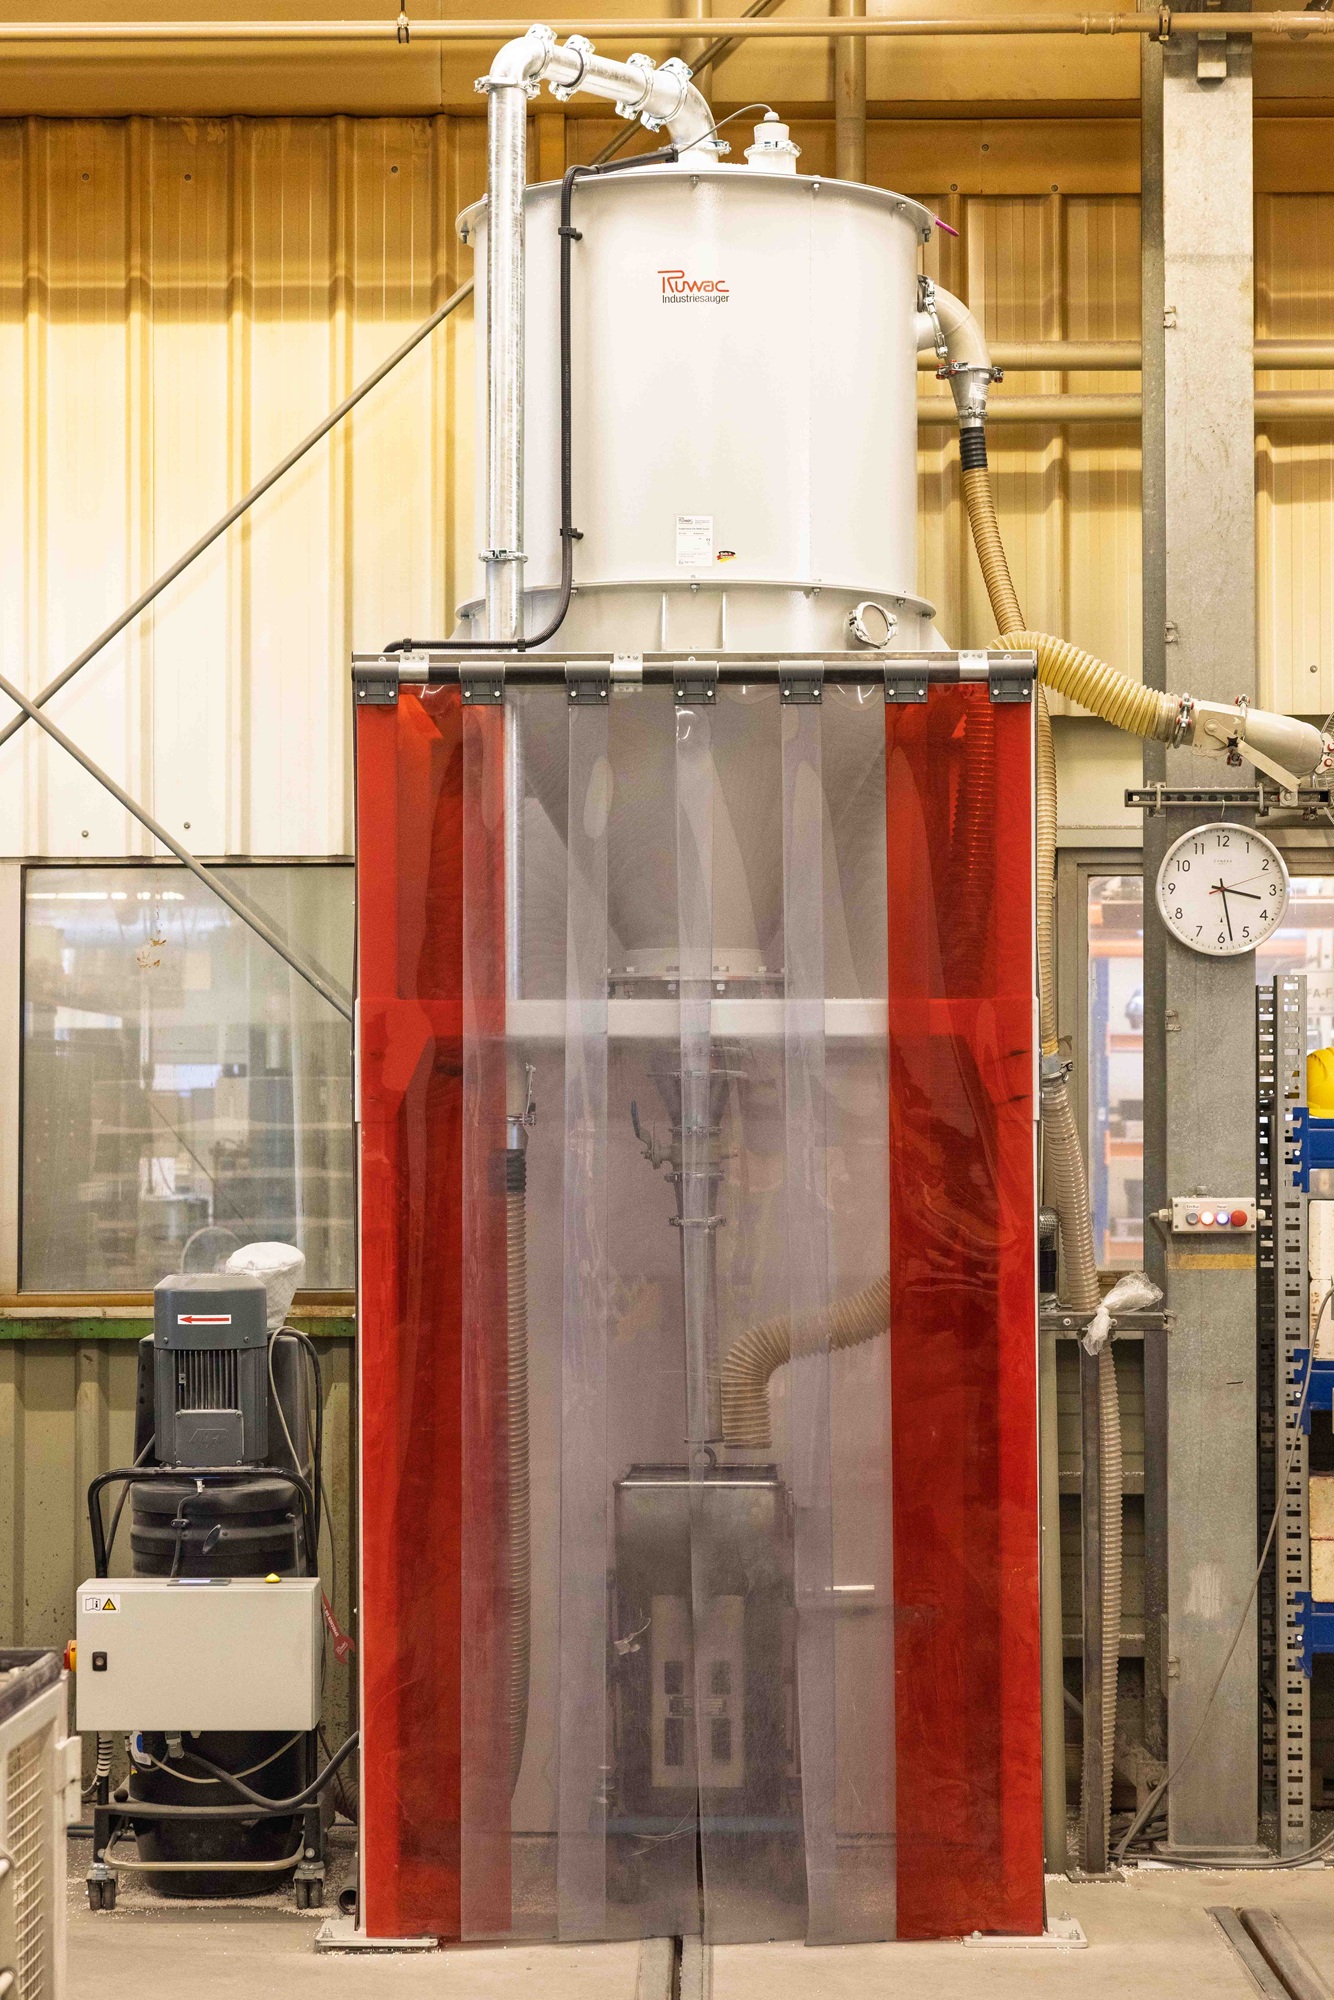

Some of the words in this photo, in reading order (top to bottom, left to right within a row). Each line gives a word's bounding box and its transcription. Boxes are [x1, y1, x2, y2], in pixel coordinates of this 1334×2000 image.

[657, 270, 729, 293] Ruwac
[662, 294, 729, 304] Industriesauger
[1216, 835, 1230, 847] 12
[1193, 843, 1205, 854] 11
[1245, 842, 1250, 853] 1
[1176, 860, 1191, 872] 10
[1261, 859, 1270, 871] 2
[1167, 882, 1176, 894] 9
[1269, 884, 1277, 896] 3
[1174, 907, 1183, 919] 8
[1259, 909, 1268, 921] 4
[1195, 925, 1203, 937] 7
[1241, 926, 1250, 938] 5
[1217, 932, 1226, 943] 6
